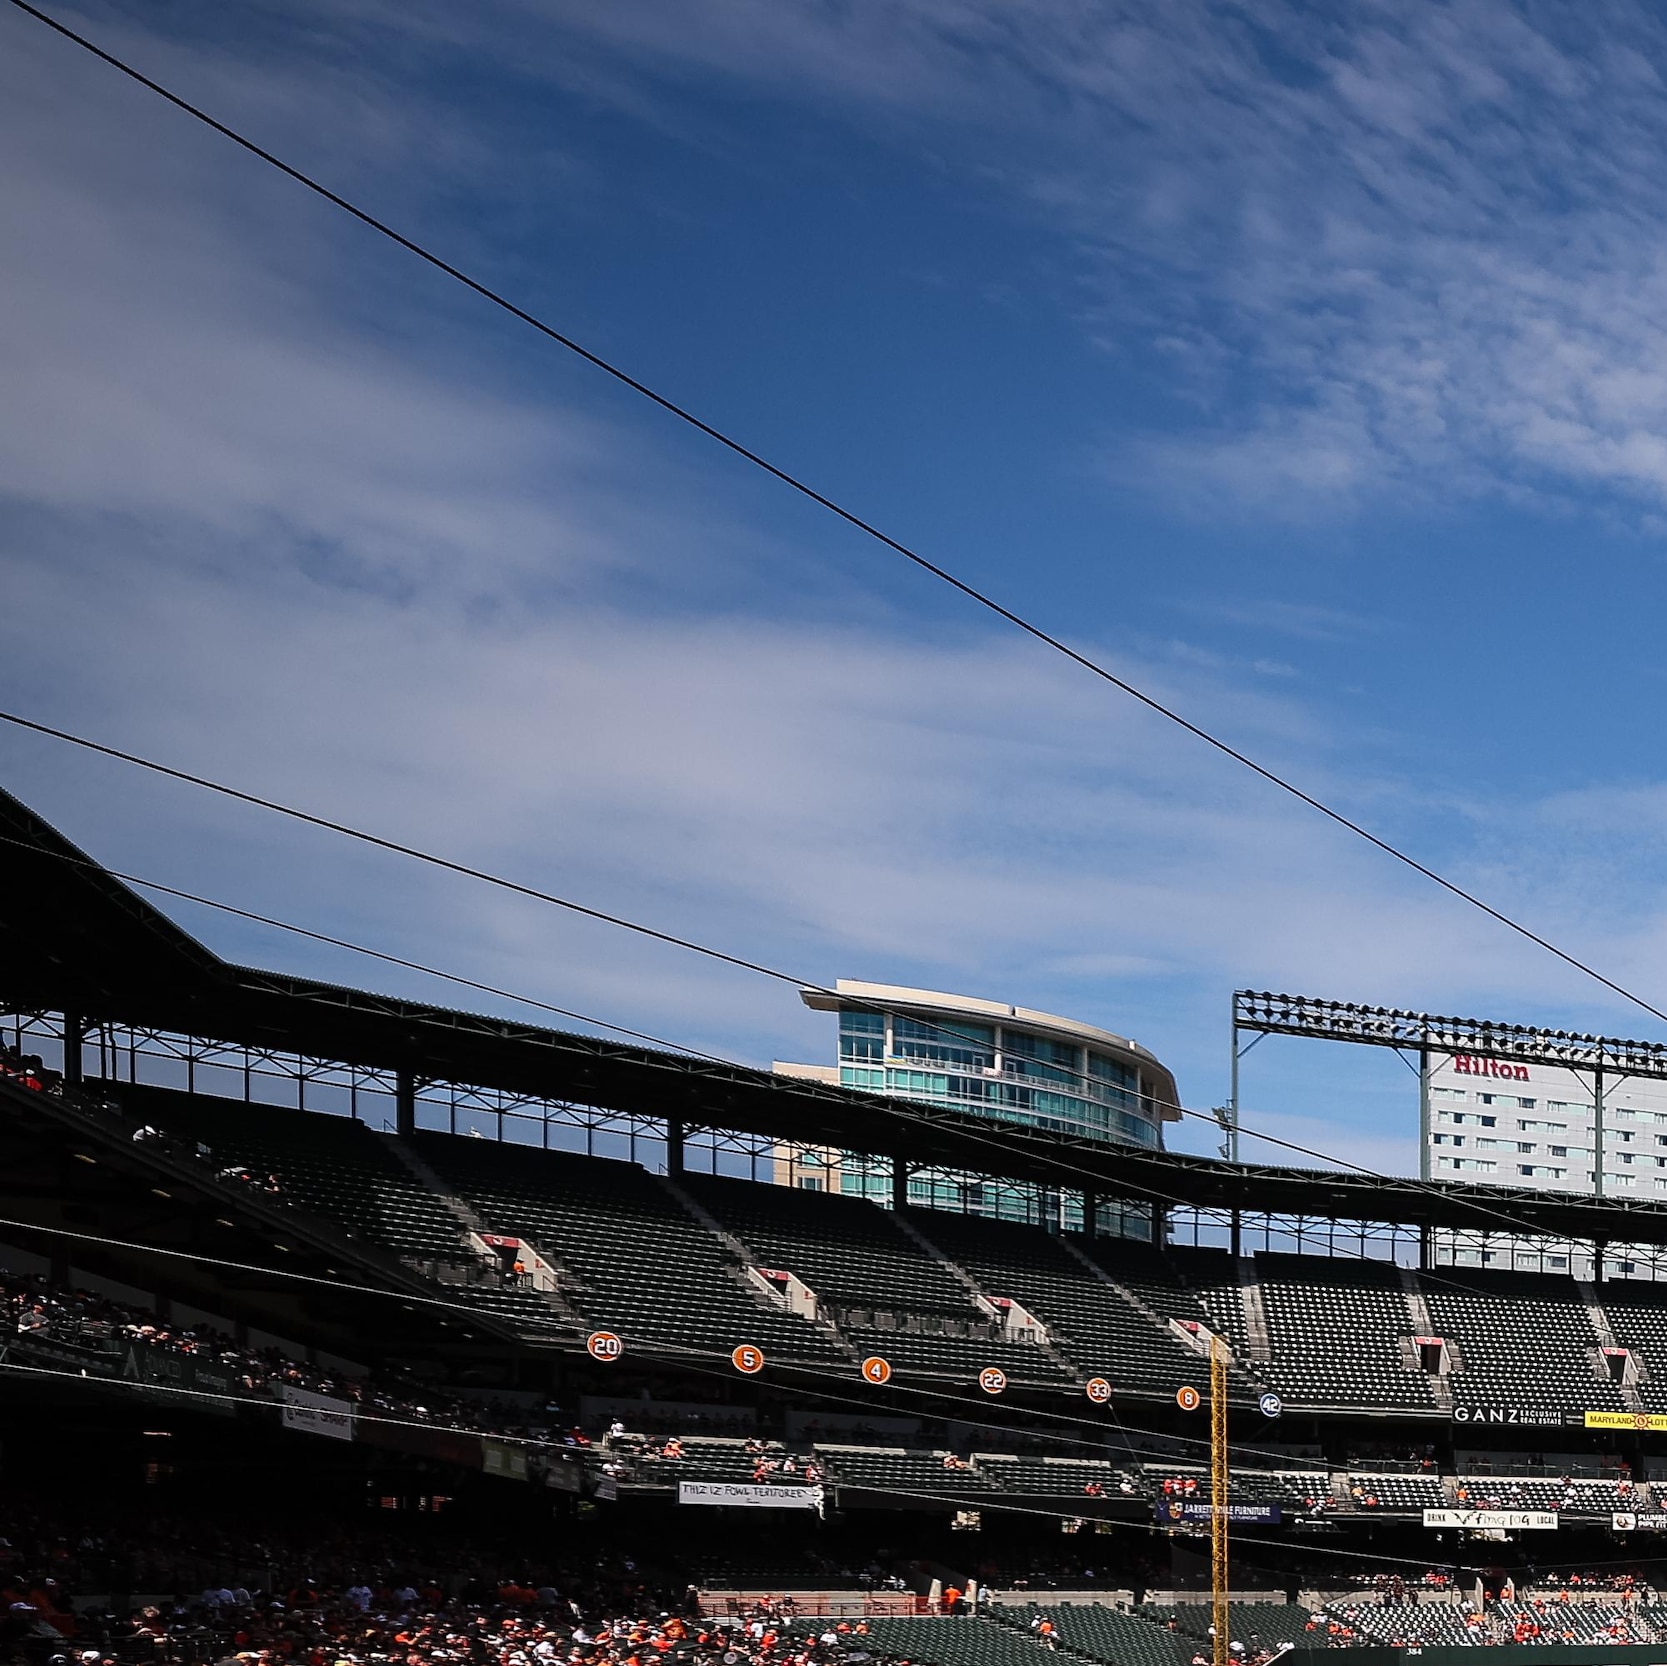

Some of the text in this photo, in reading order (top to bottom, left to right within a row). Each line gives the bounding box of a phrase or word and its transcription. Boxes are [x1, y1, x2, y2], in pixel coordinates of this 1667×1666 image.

[1454, 1054, 1530, 1082] Hilton
[594, 1336, 618, 1354] 20
[744, 1352, 754, 1367] 5
[871, 1364, 881, 1378] 4
[984, 1373, 1002, 1387] 22
[1091, 1383, 1108, 1396] 33
[1184, 1393, 1194, 1405] 8
[1263, 1398, 1278, 1411] 42
[1454, 1406, 1519, 1423] GANZ
[1590, 1416, 1632, 1425] MARYLAND
[725, 1486, 749, 1496] FOWL
